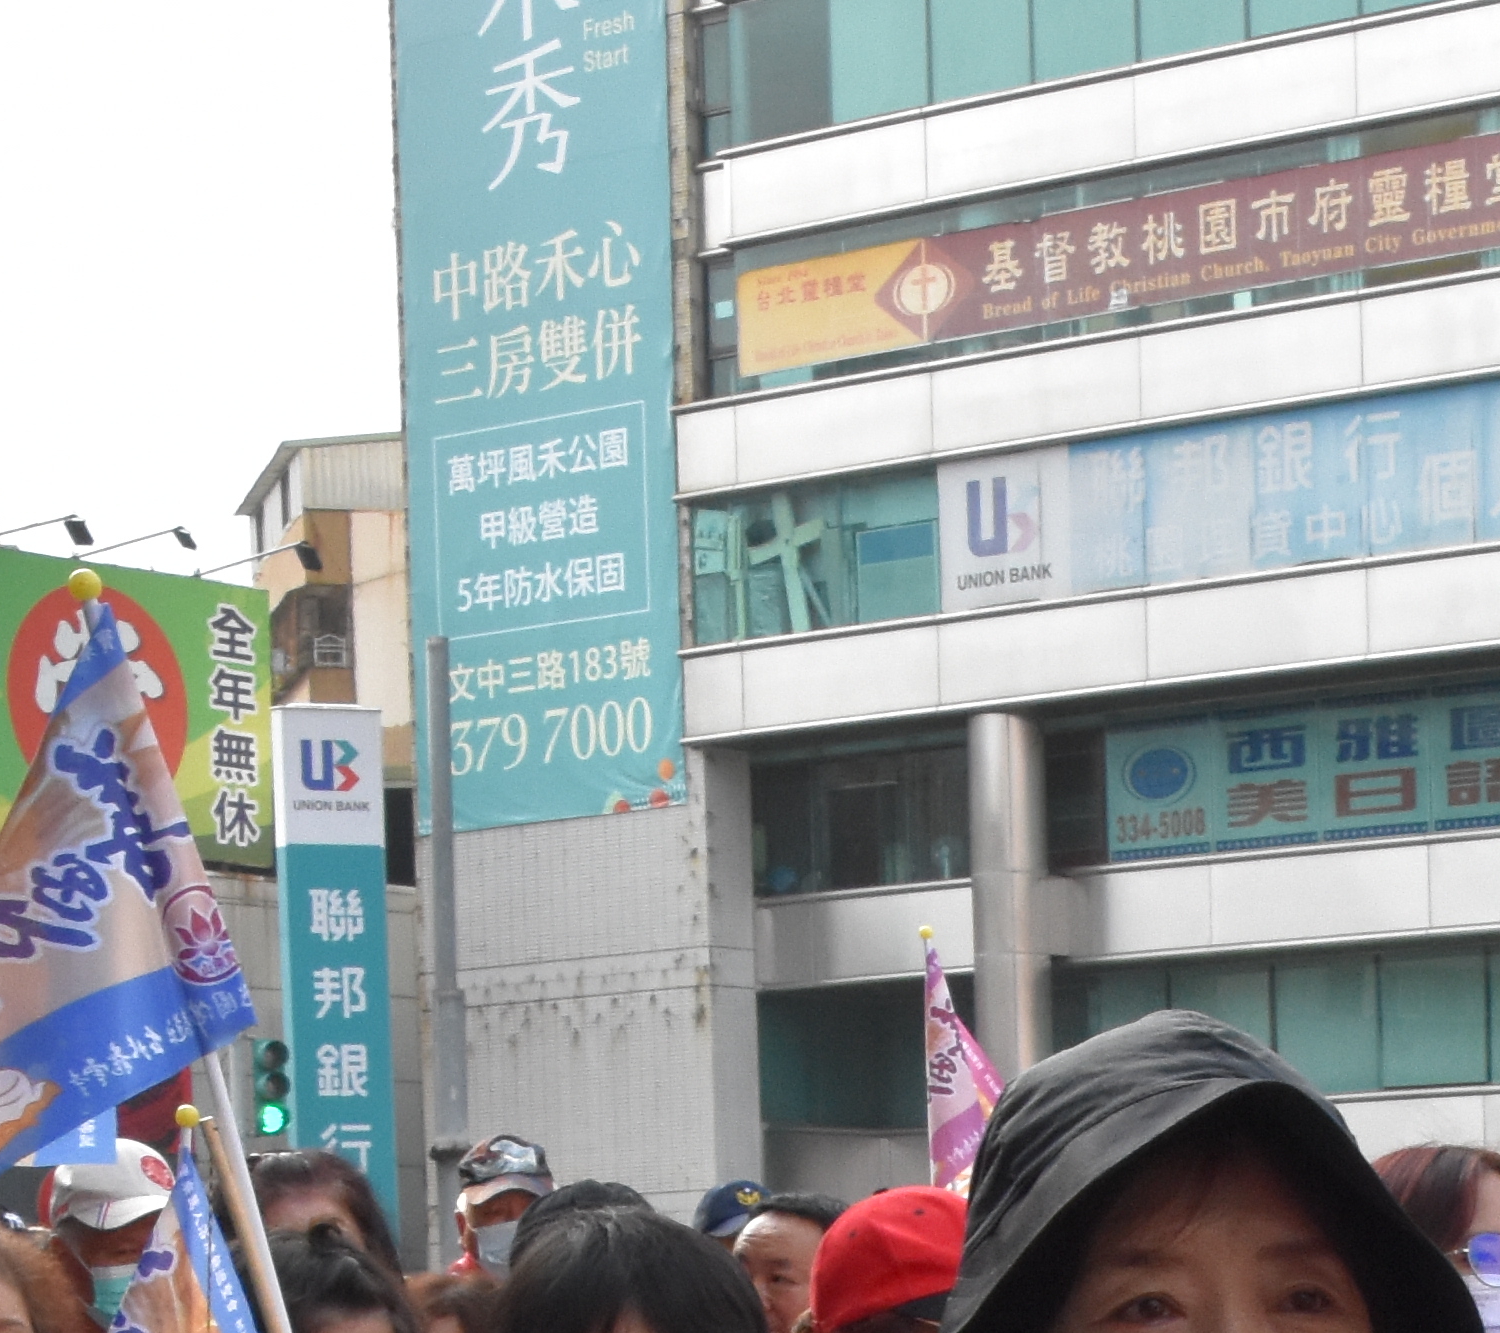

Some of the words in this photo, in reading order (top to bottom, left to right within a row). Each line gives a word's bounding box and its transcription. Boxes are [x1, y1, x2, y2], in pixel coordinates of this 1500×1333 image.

[582, 11, 634, 39] Fresh
[582, 46, 629, 73] Start
[432, 222, 641, 323] 中路禾心
[982, 299, 1032, 320] Bread
[1041, 294, 1058, 310] of
[1067, 286, 1100, 306] Life
[1110, 271, 1191, 297] Christian
[1281, 244, 1355, 272] Taoyuan
[1365, 234, 1403, 259] City
[434, 304, 642, 405] 三房雙併
[448, 428, 628, 496] 萬坪風禾公園
[1087, 410, 1402, 513] 聯邦銀行
[479, 497, 599, 551] 甲級營造
[457, 552, 625, 613] 5年防水保固
[956, 570, 1004, 591] UNION
[1011, 564, 1053, 584] BANK
[450, 637, 652, 702] 文中三路183號
[208, 604, 261, 846] 全年無休
[542, 697, 653, 764] 7000
[292, 800, 328, 812] UNION
[331, 801, 371, 813] BANK
[310, 888, 373, 1174] 聯邦銀行
